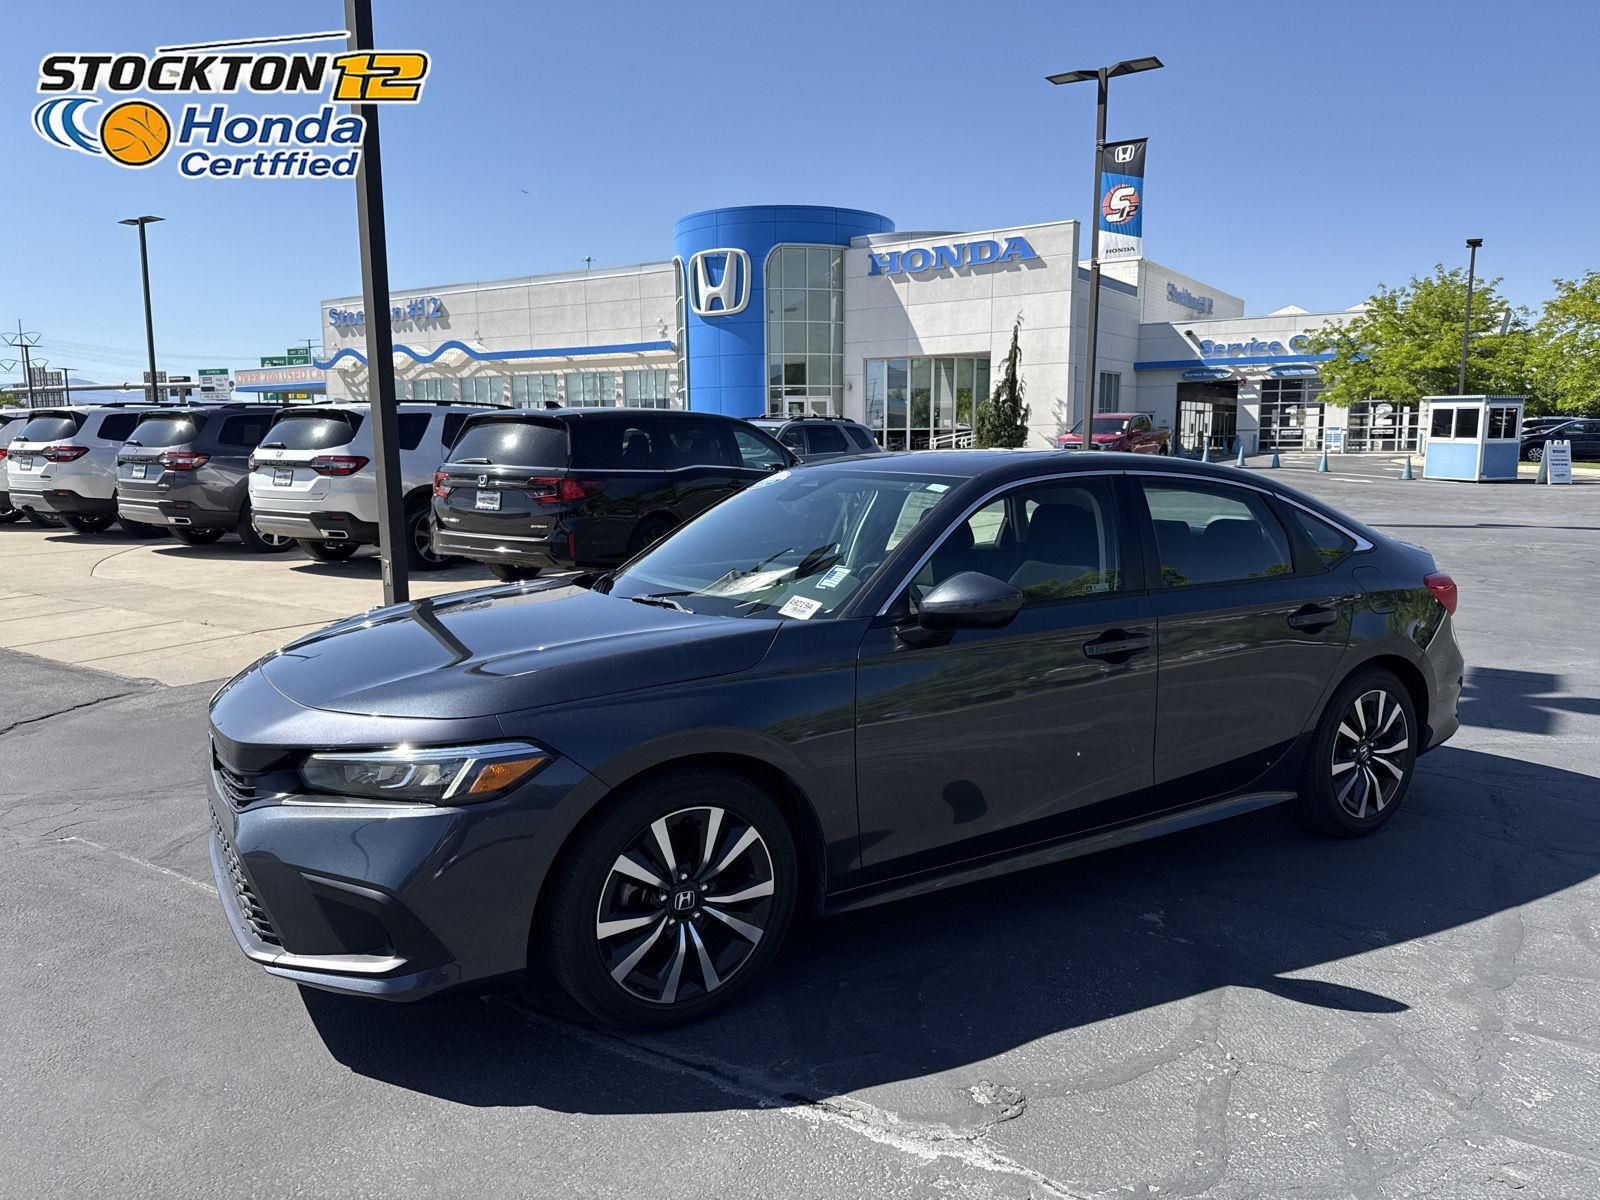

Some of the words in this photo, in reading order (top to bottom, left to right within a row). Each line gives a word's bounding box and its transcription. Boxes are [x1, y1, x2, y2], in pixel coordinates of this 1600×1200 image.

[867, 236, 1038, 276] HONDA
[1105, 246, 1136, 254] HONDA
[328, 305, 403, 327] Stocn
[407, 297, 441, 321] #12
[1200, 337, 1283, 357] Service
[1374, 403, 1393, 426] 2
